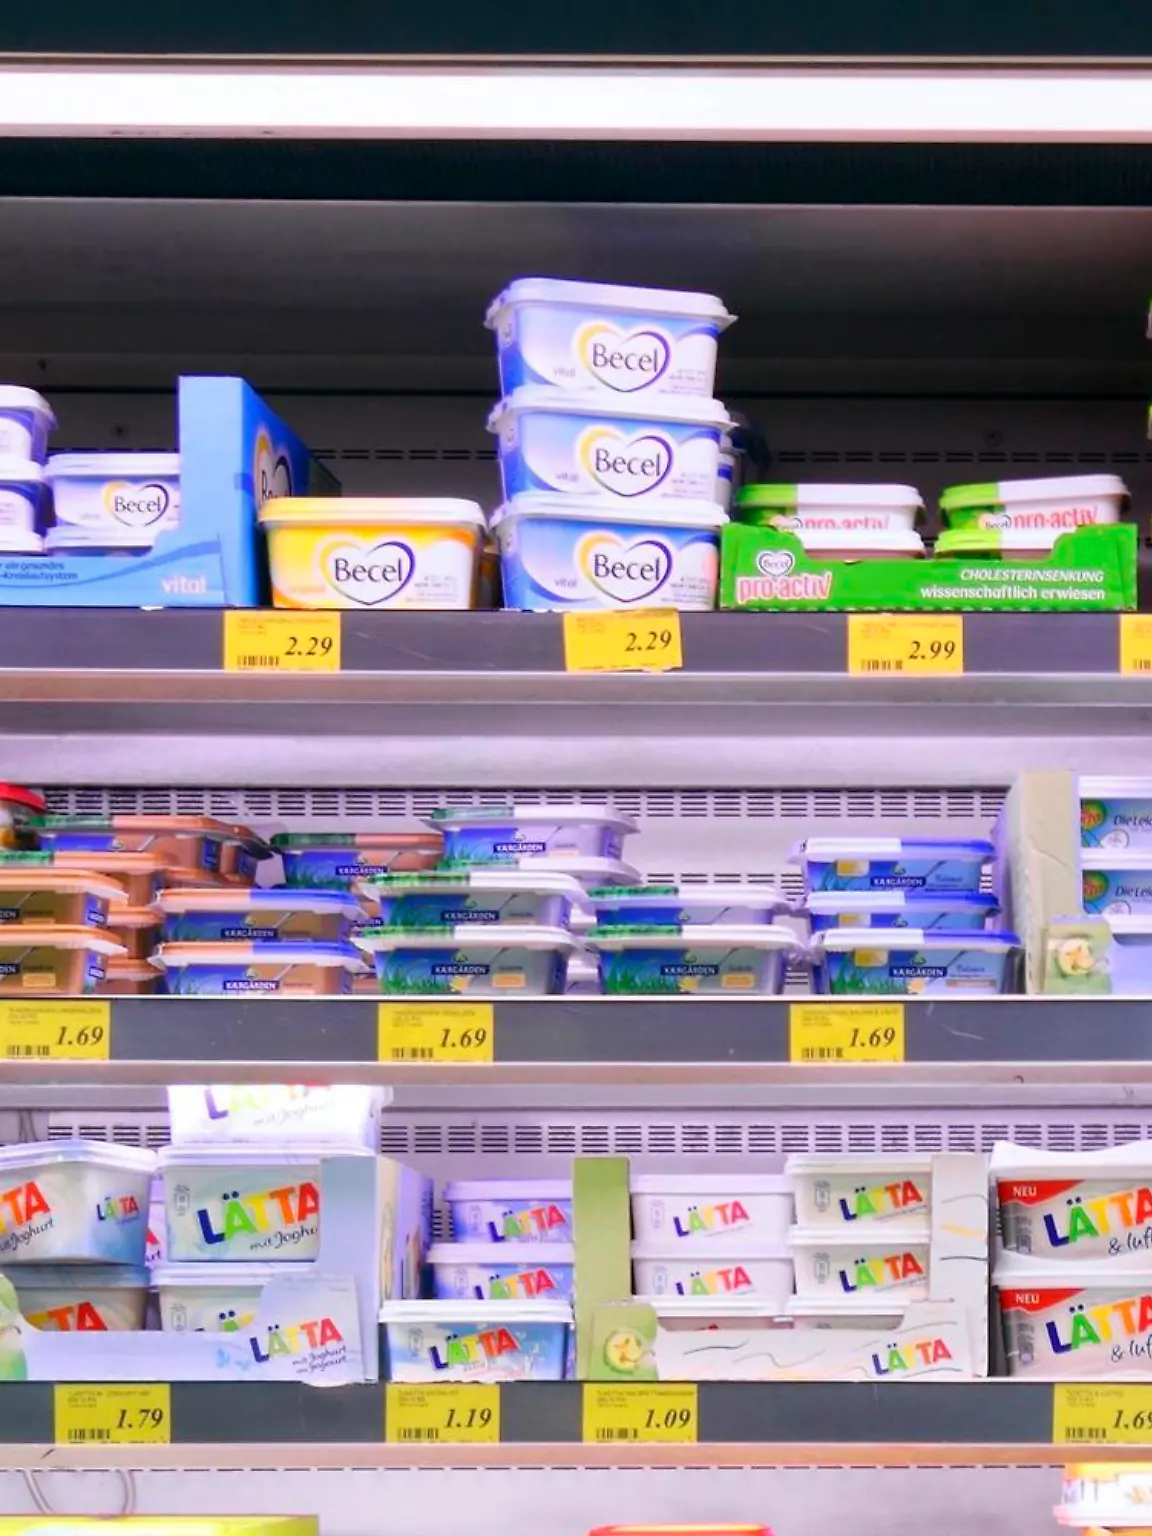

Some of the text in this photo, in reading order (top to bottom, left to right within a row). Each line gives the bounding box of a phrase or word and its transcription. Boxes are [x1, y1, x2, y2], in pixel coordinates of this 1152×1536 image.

[592, 344, 660, 373] Becel
[594, 448, 661, 477] Becel
[114, 486, 162, 512] Becel
[335, 557, 403, 583] Becel
[594, 554, 661, 582] Becel
[960, 568, 1104, 583] CHOLESTERINSENKUNG
[161, 576, 208, 595] vital
[920, 584, 1105, 601] wissenschaftlich erwiesen
[285, 636, 333, 658] 2.29
[625, 630, 673, 652] 2.29
[908, 641, 956, 660] 2.99
[56, 1025, 104, 1046] 1.69
[439, 1028, 487, 1048] 1.69
[849, 1027, 896, 1048] 1.69
[1012, 1185, 1037, 1198] NEU
[1107, 1239, 1123, 1255] &
[1015, 1293, 1040, 1305] NEU
[428, 1327, 521, 1372] LÄTTA
[871, 1337, 954, 1376] LÄTTA
[1111, 1346, 1126, 1362] &
[116, 1408, 163, 1429] 1.79
[445, 1408, 492, 1429] 1.19
[644, 1408, 691, 1429] 1.09
